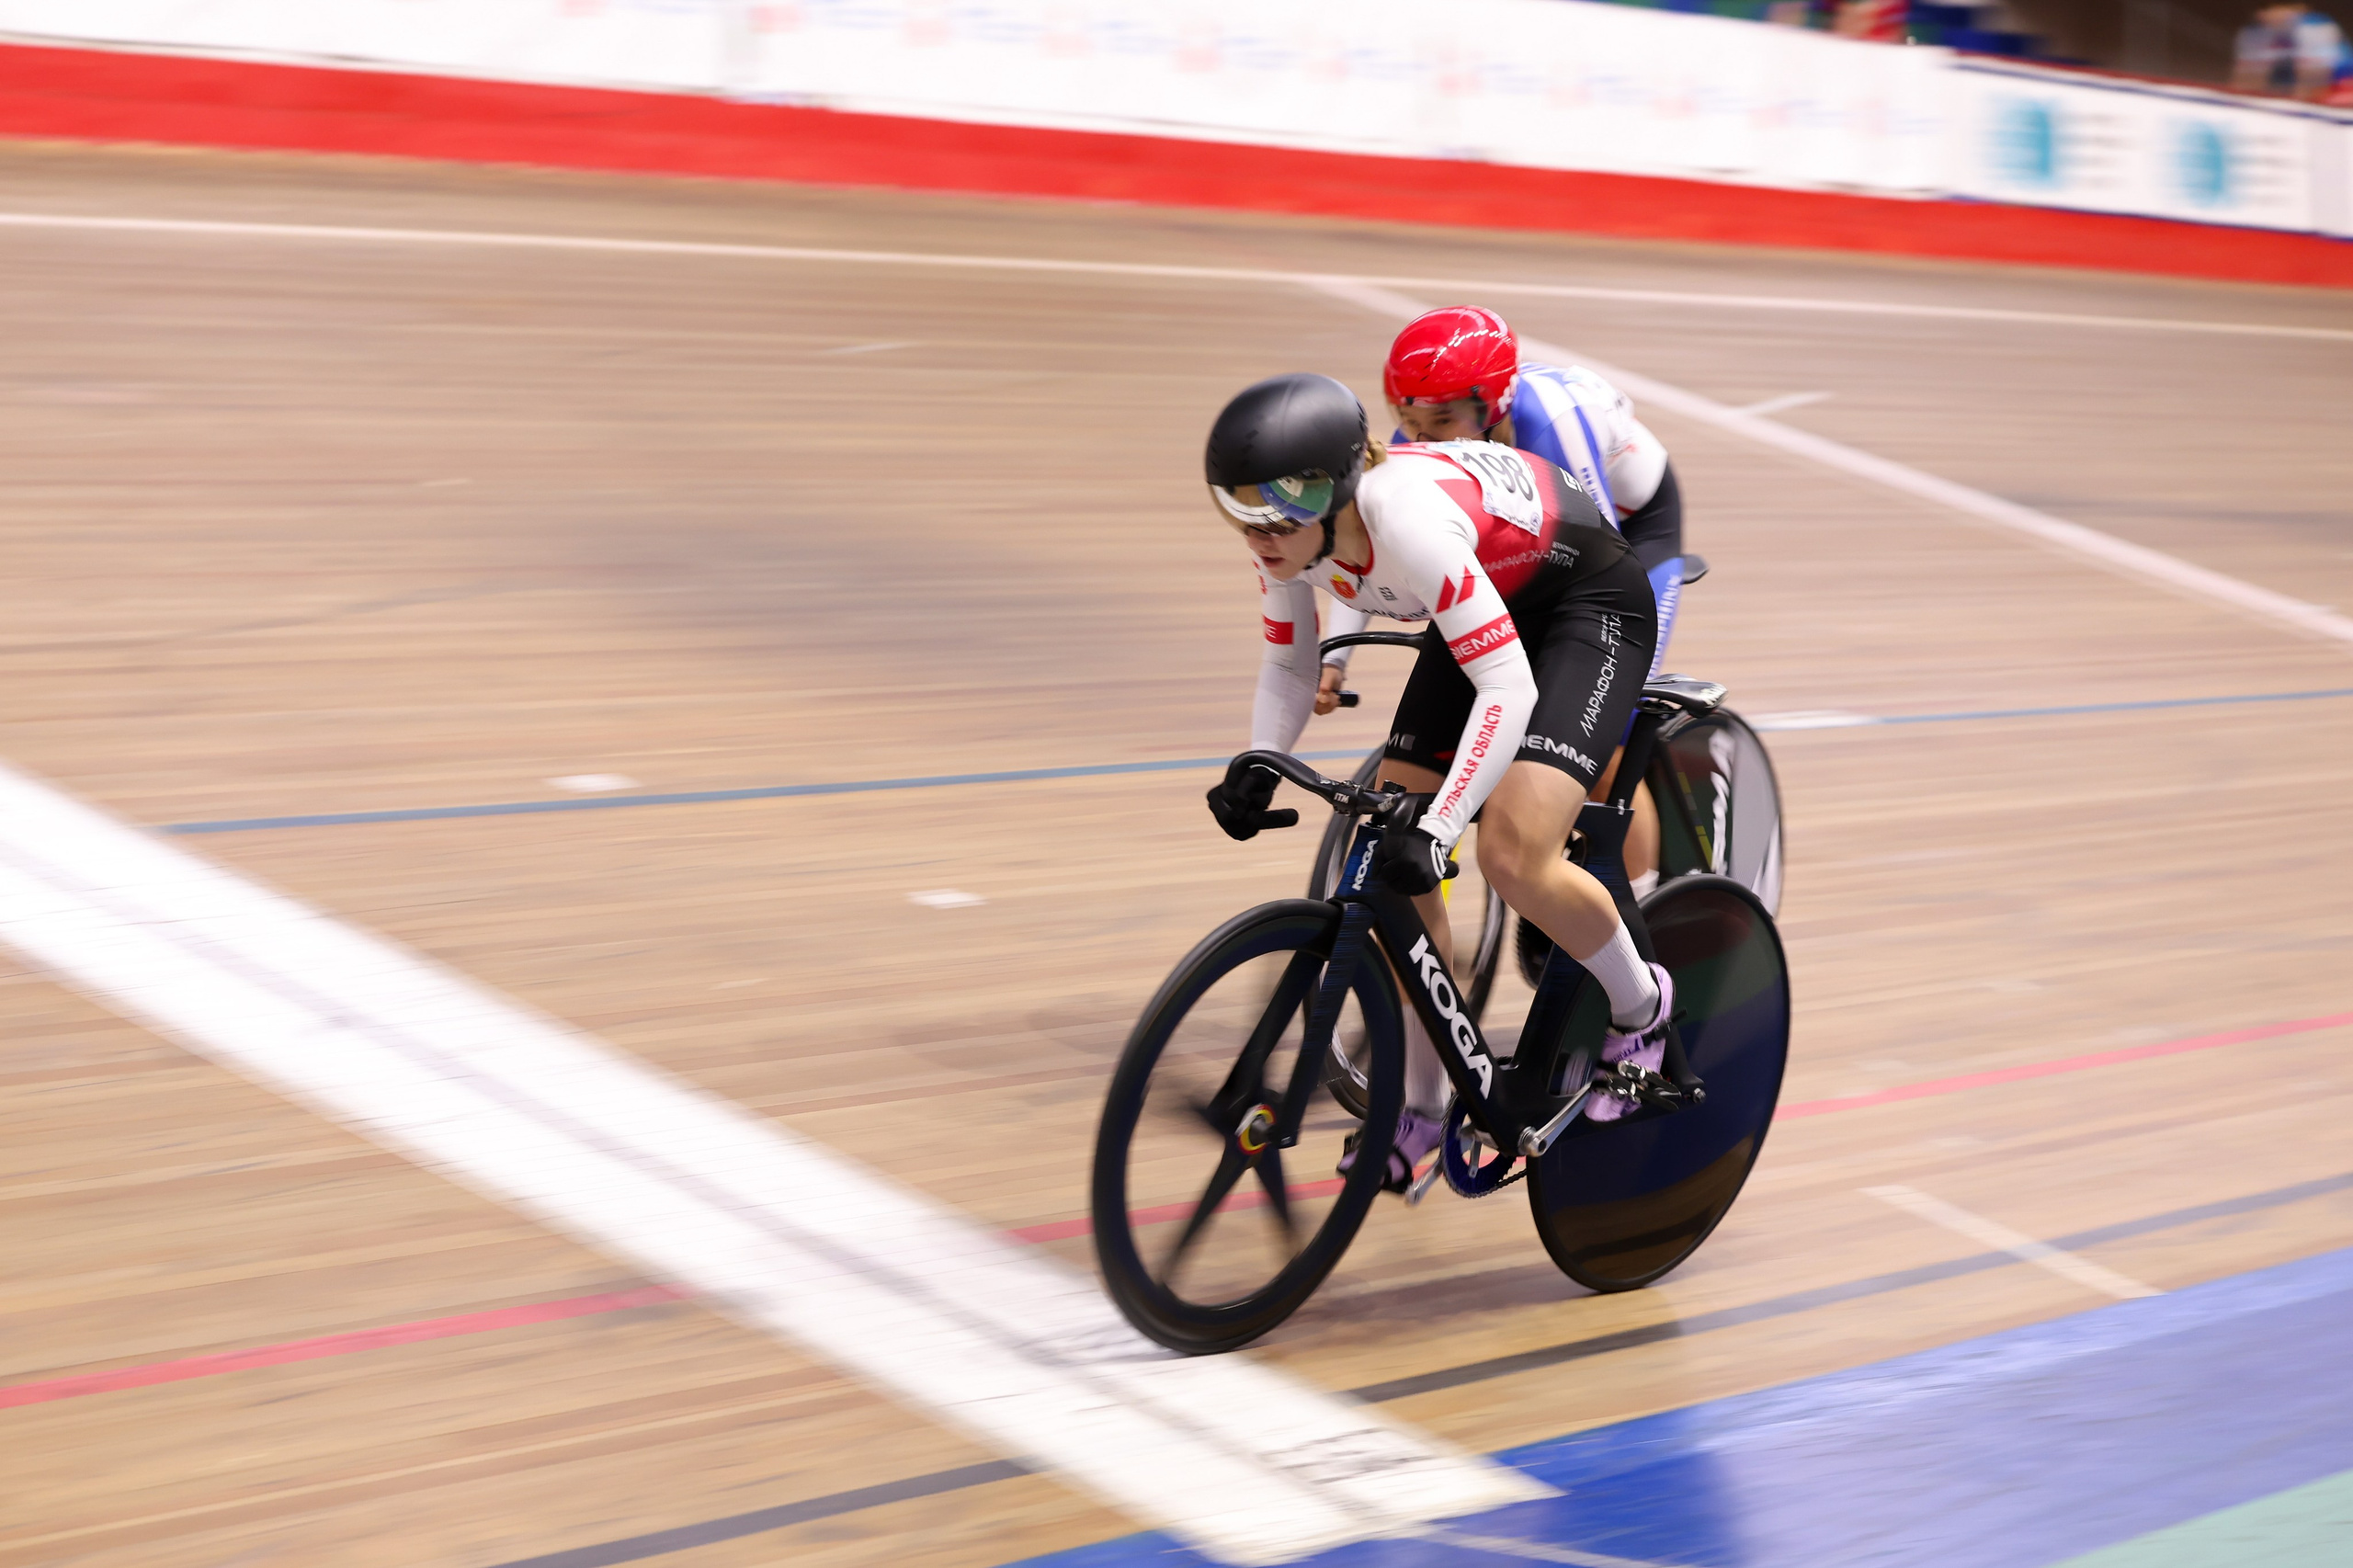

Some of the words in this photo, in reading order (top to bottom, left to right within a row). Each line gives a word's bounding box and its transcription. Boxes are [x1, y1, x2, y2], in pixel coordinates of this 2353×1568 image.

[1461, 452, 1534, 501] 198
[1438, 759, 1480, 818] ТУЛЬСКАЯ
[1472, 704, 1503, 758] ОБЛАСТЬ
[1520, 733, 1598, 777] IEMME
[1334, 792, 1349, 804] ITM
[1351, 839, 1379, 892] KOGA
[1408, 933, 1494, 1101] KOGA
